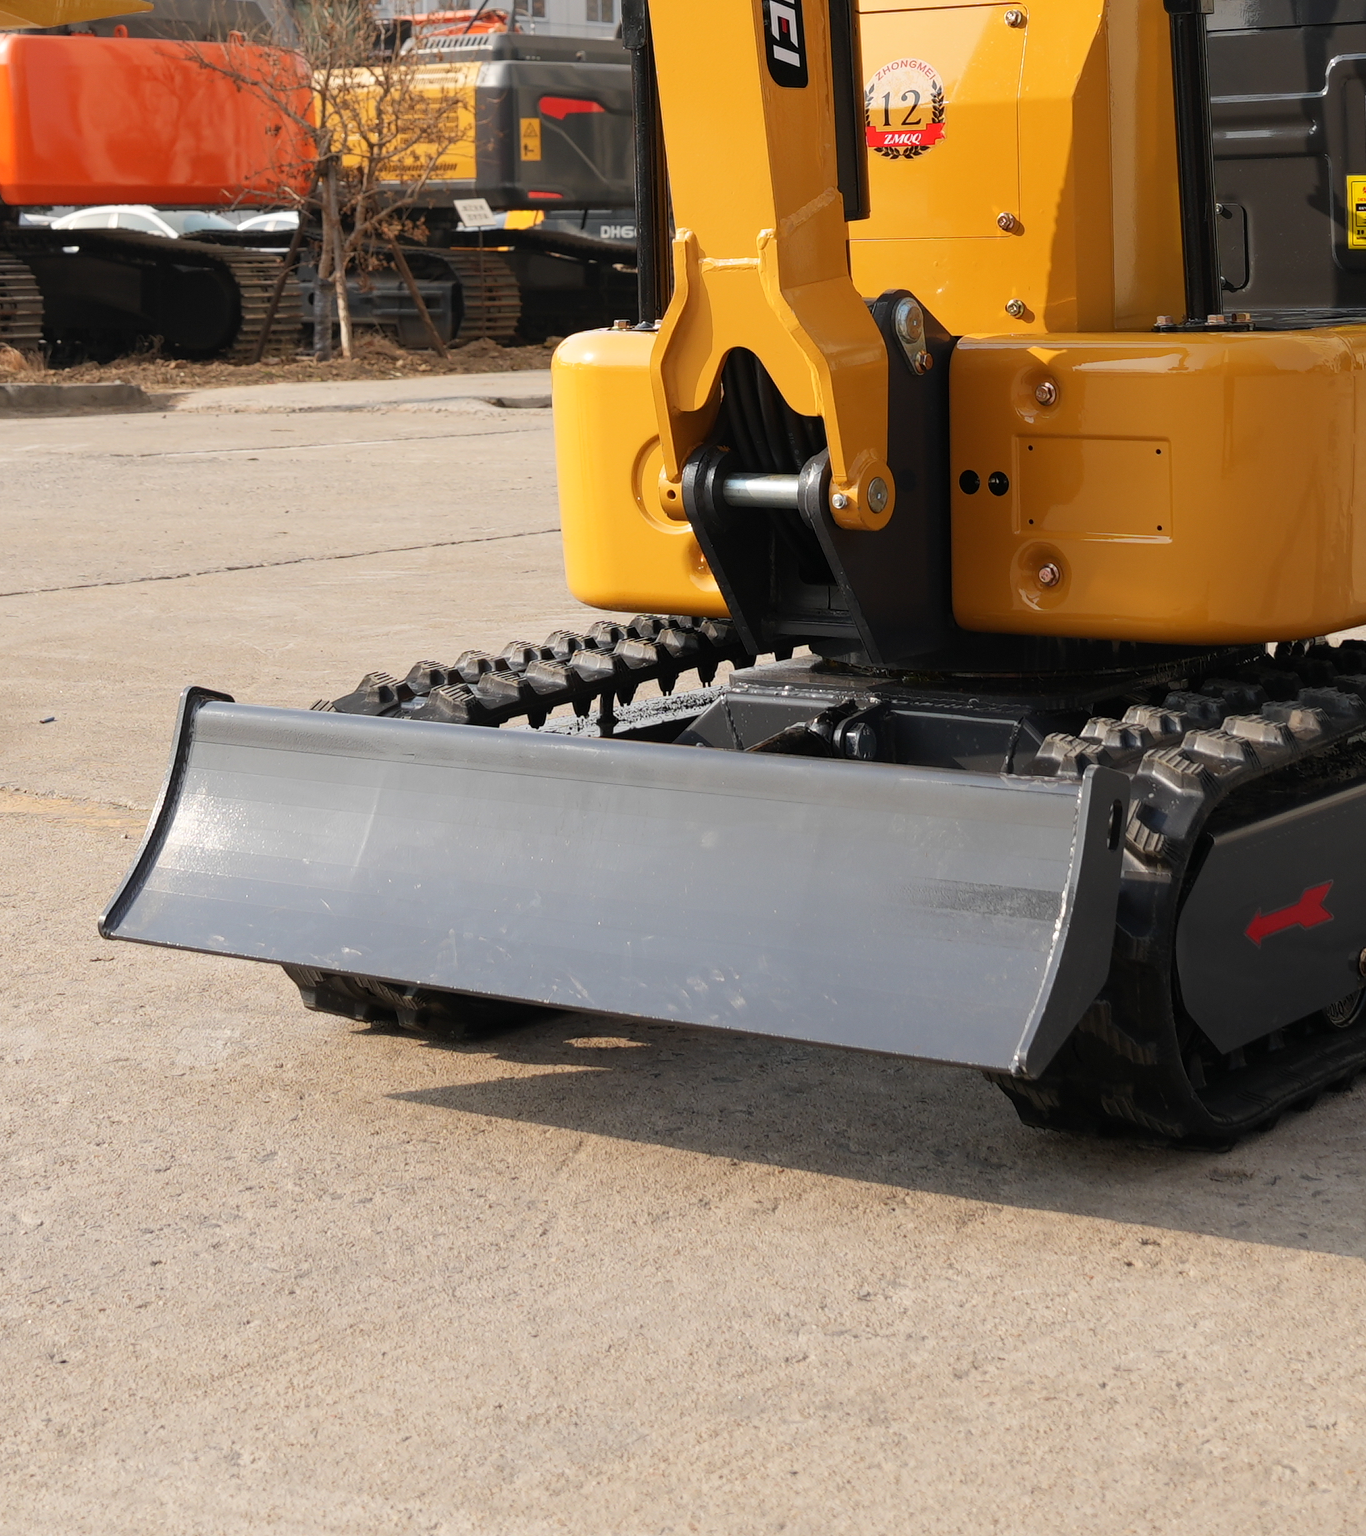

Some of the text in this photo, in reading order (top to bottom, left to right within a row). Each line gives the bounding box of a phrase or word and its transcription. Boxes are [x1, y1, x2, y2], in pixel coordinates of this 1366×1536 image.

[875, 59, 936, 81] ZHONGMEI
[882, 89, 922, 126] 12
[883, 133, 922, 145] ZMQQ
